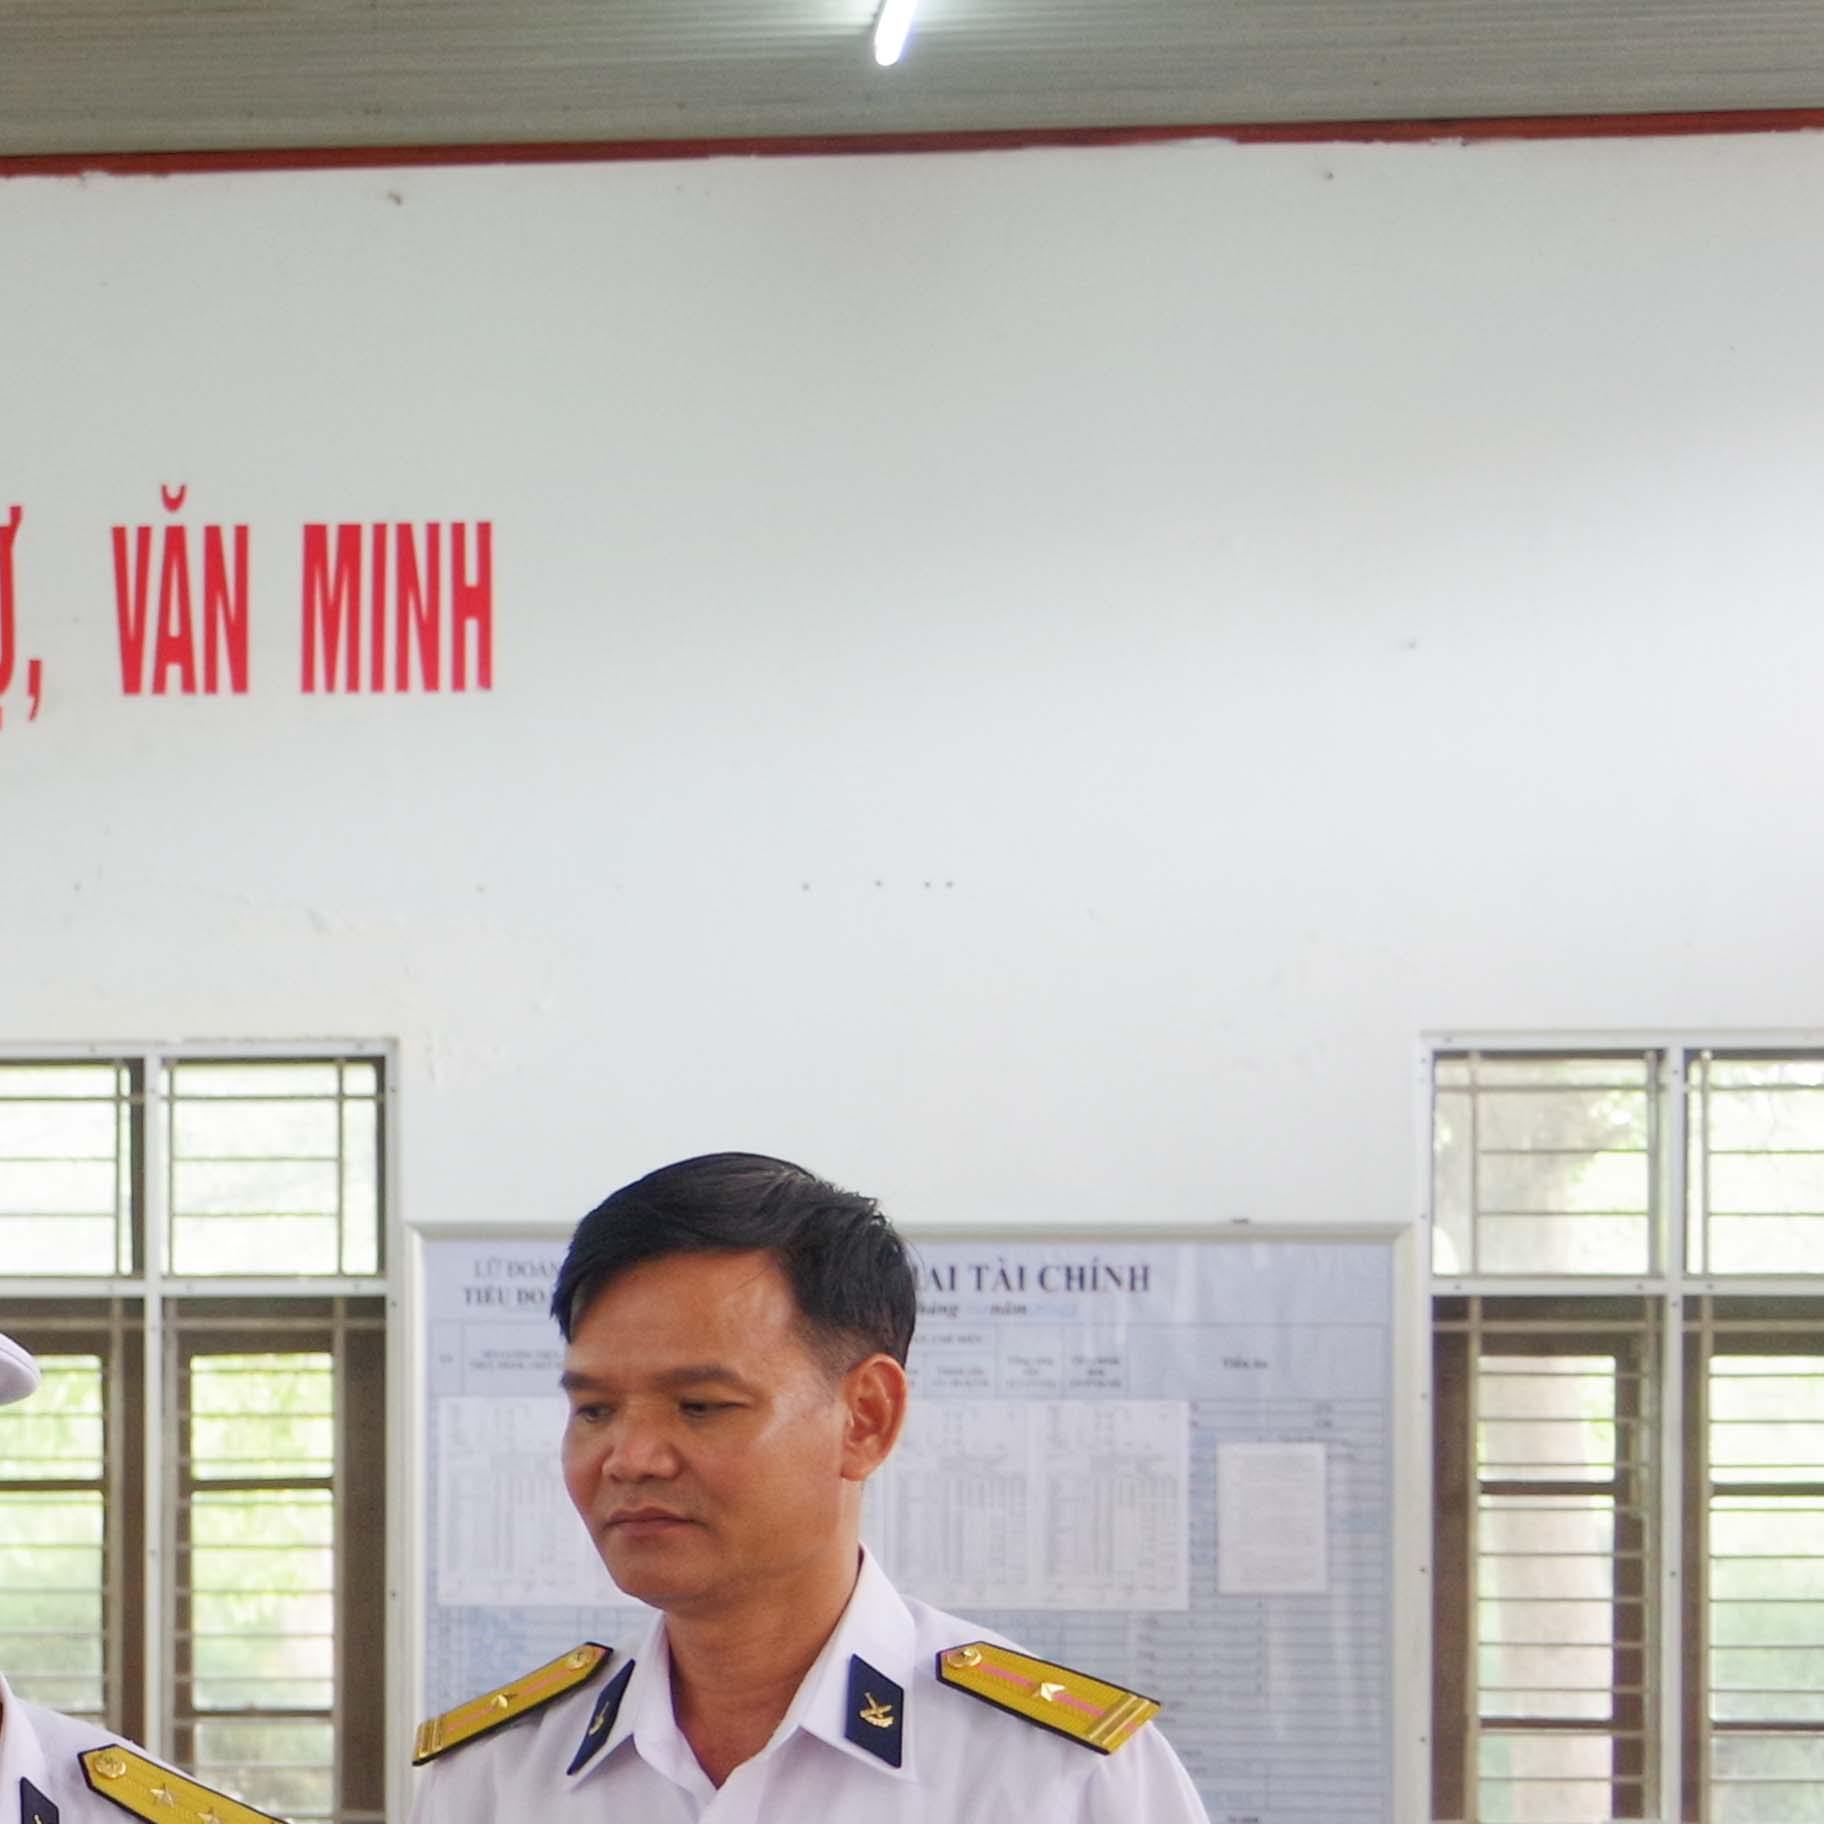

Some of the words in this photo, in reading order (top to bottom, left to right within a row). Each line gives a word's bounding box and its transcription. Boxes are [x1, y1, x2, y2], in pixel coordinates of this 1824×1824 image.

[112, 484, 250, 697] VĂN
[301, 521, 493, 694] MINH
[968, 1257, 1025, 1293] TÀI
[1037, 1256, 1151, 1293] CHÍNH
